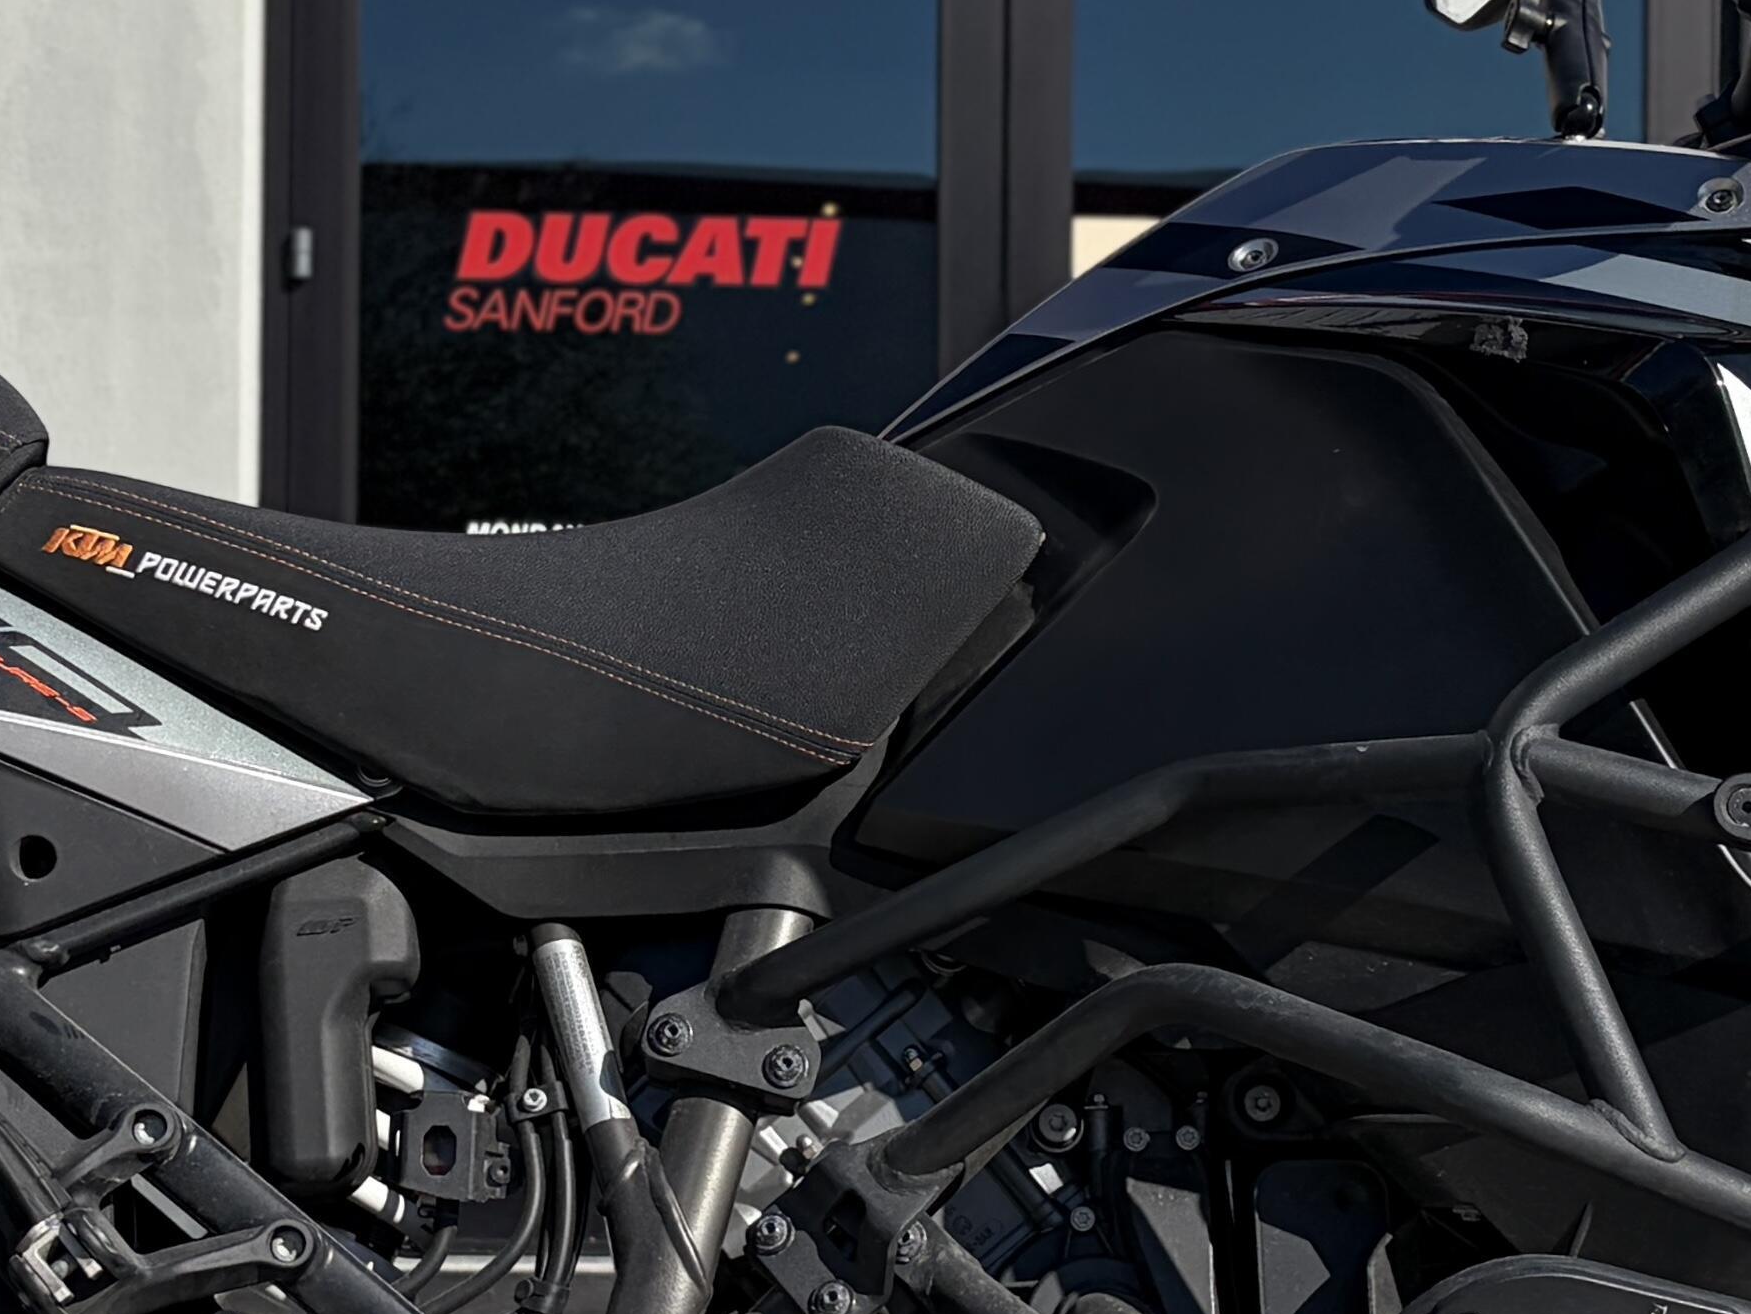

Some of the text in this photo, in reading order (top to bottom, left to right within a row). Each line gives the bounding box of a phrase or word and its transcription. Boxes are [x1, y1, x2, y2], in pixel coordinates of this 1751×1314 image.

[456, 211, 841, 287] DUCATI
[443, 286, 683, 334] SANFORD
[135, 551, 330, 631] POWERPARTS
